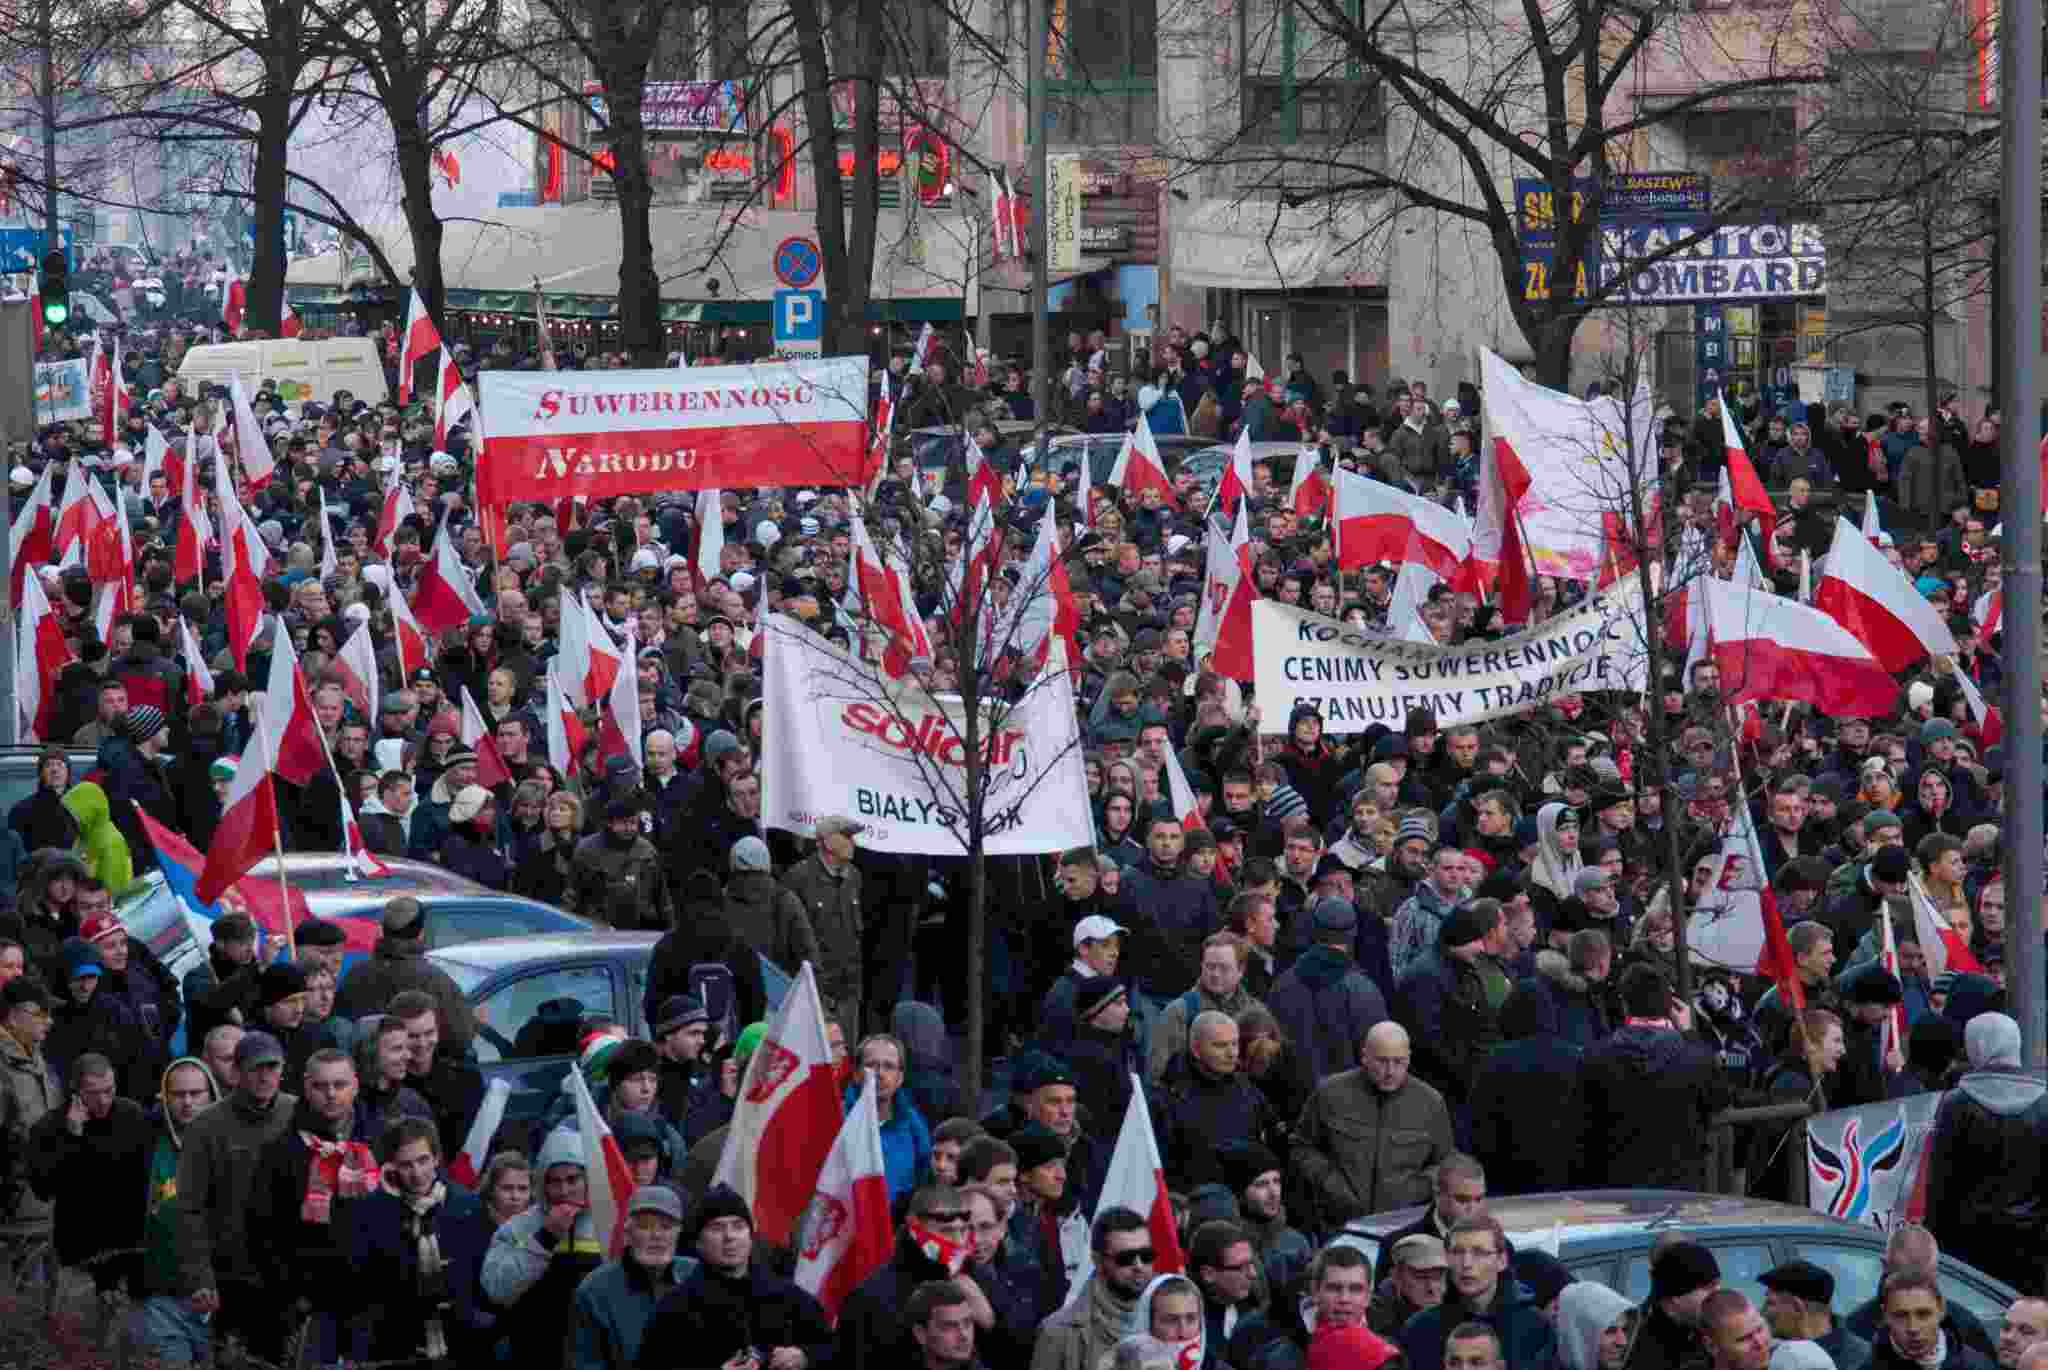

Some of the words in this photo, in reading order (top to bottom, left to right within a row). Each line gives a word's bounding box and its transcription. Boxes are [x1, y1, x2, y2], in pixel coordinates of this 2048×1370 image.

[1524, 191, 1585, 230] SKP
[1602, 224, 1825, 255] KANTOR
[785, 295, 812, 335] P
[1284, 656, 1385, 682] CENIMY
